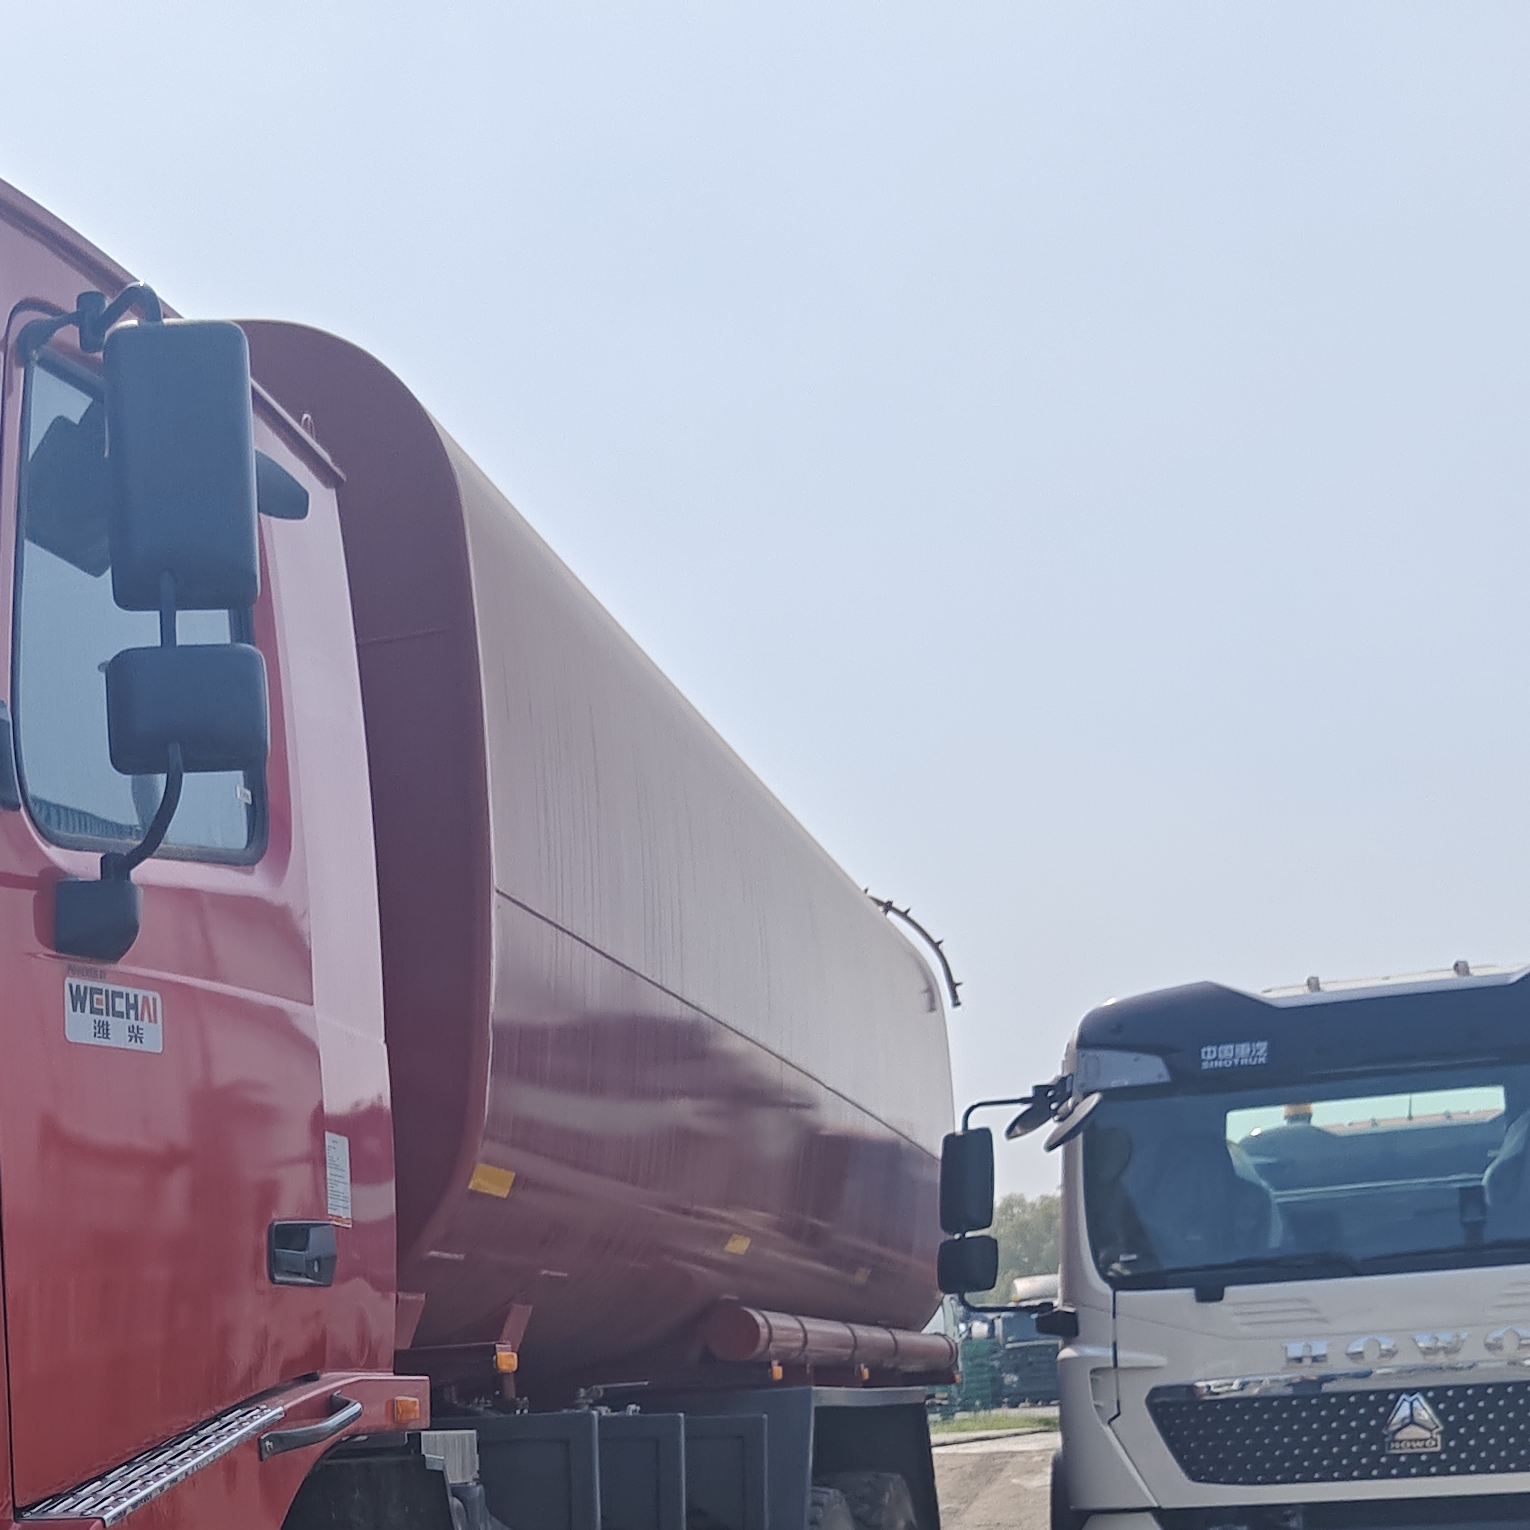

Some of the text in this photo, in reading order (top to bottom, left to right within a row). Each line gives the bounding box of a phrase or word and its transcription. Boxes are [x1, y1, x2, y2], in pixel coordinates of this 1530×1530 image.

[68, 983, 158, 1024] WEICHAI
[1201, 1056, 1267, 1069] SINOTRUK
[1283, 1327, 1530, 1369] HOWO
